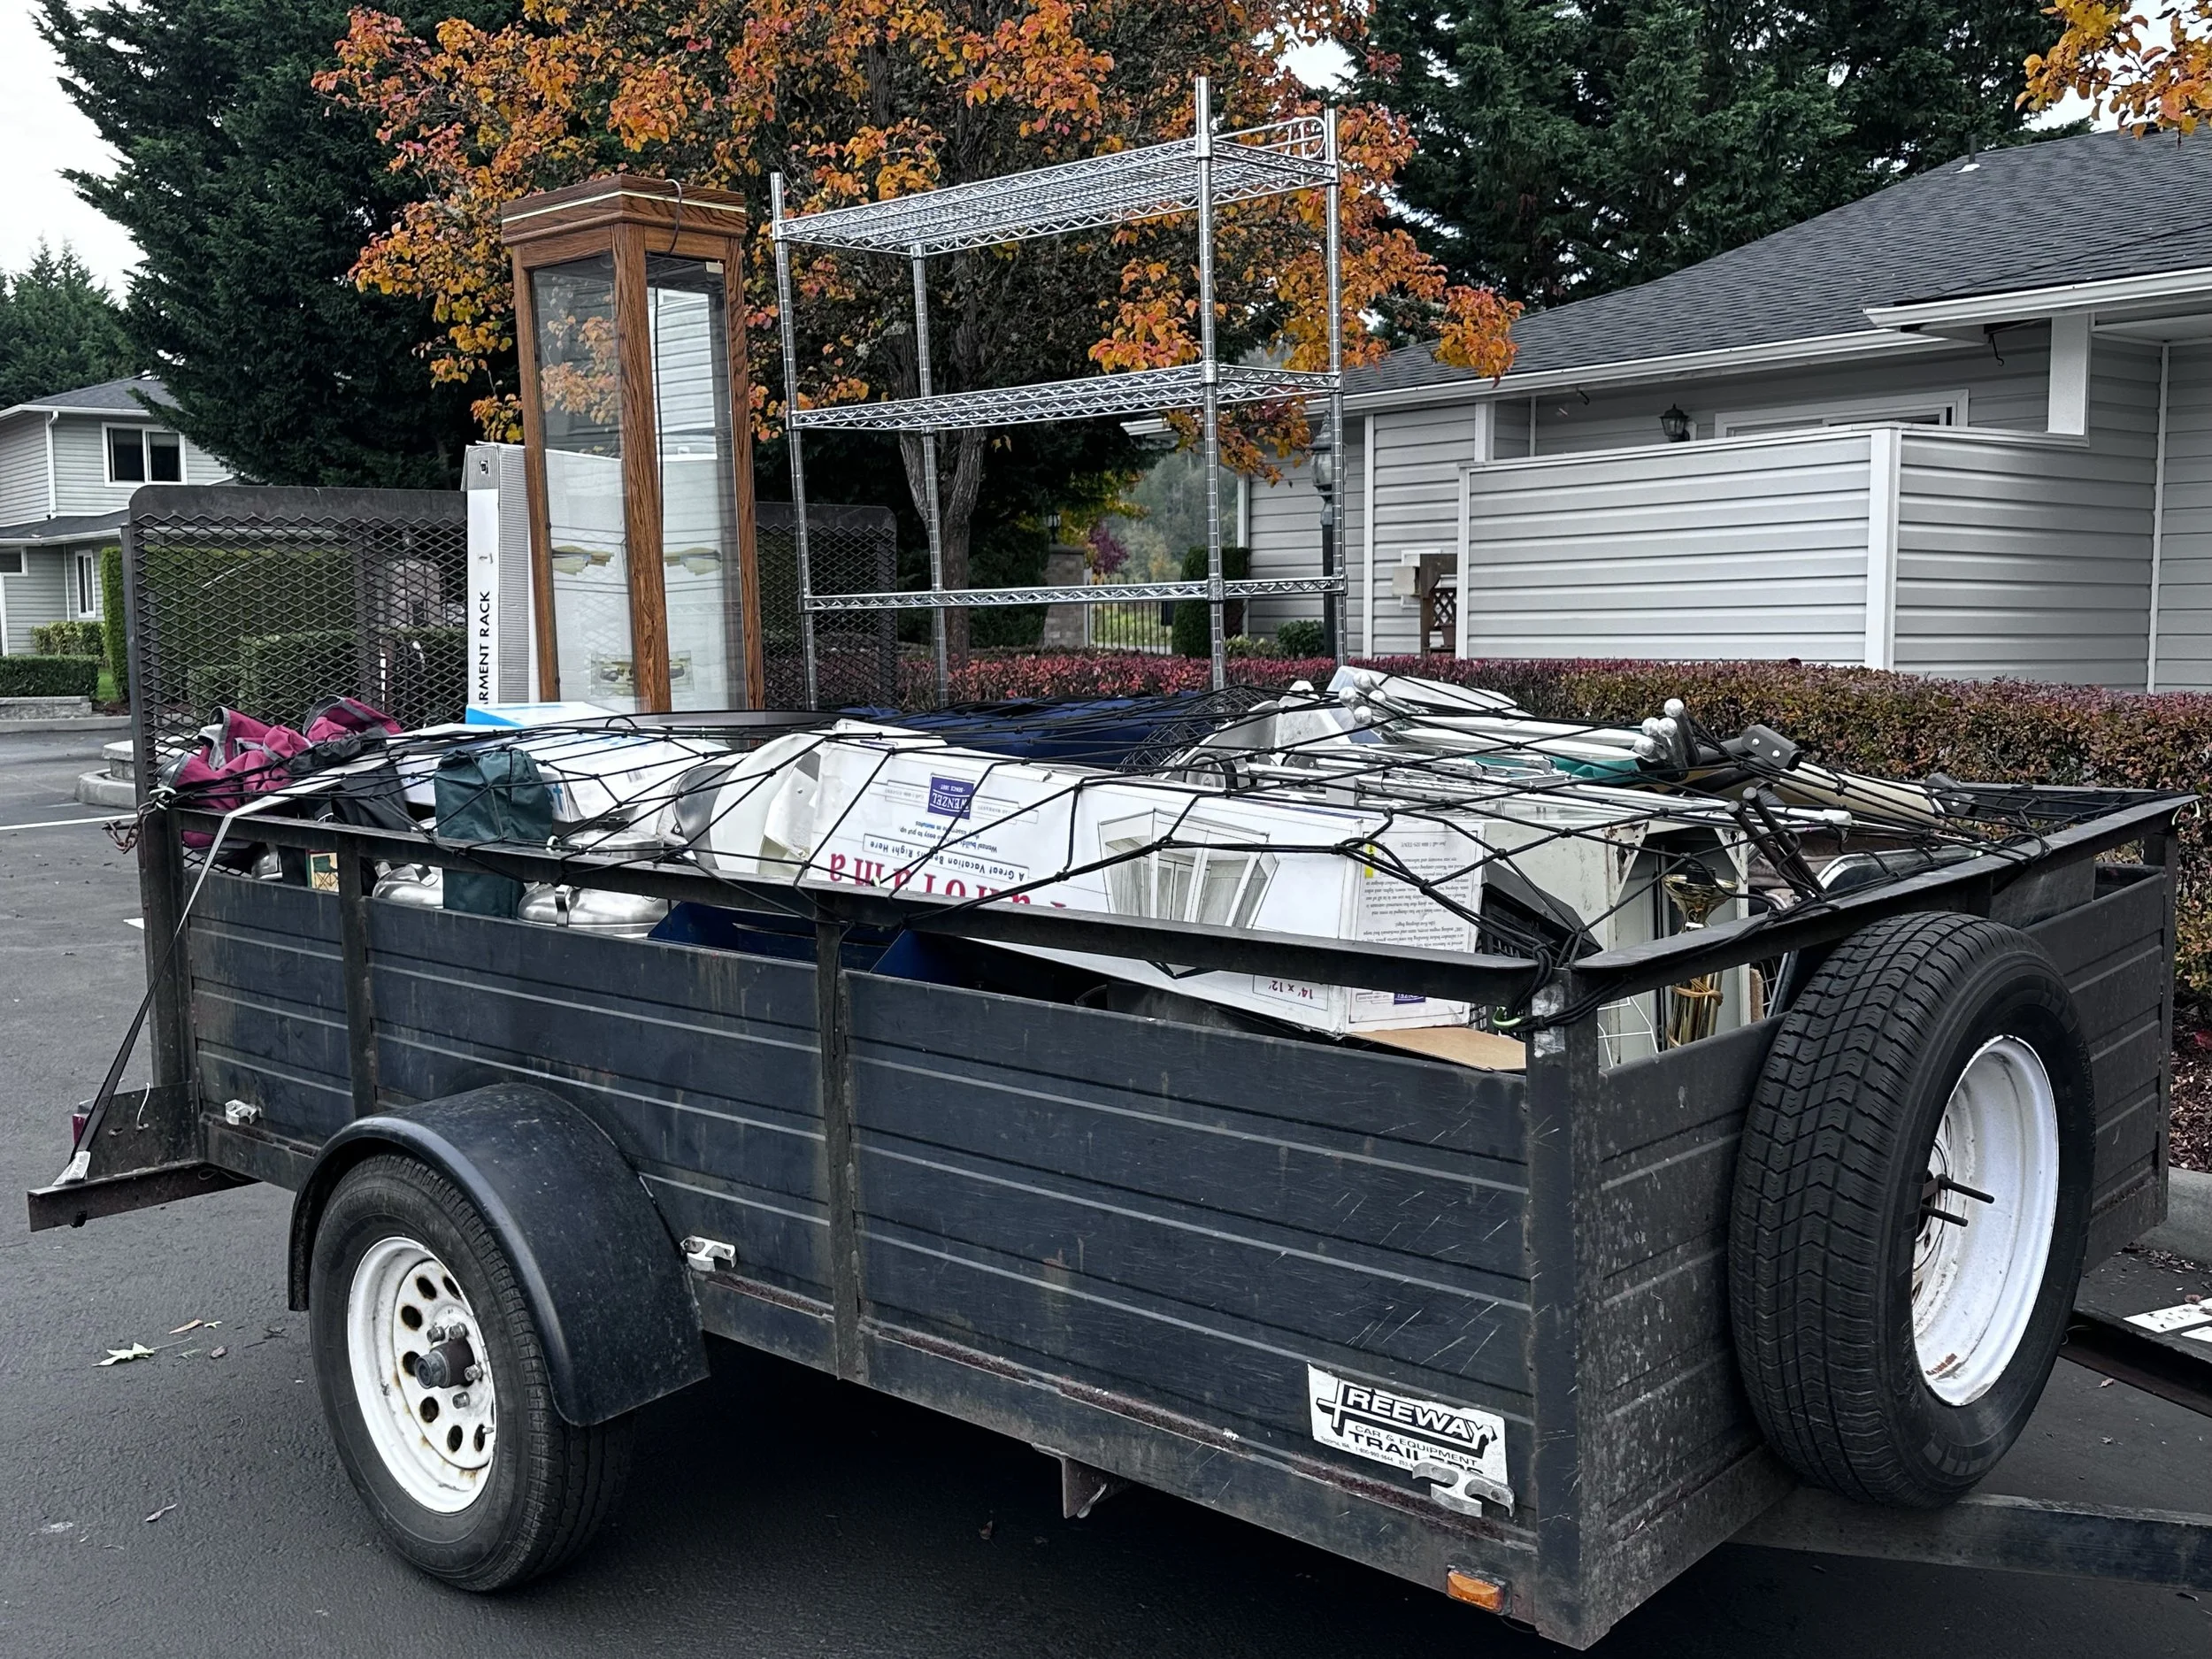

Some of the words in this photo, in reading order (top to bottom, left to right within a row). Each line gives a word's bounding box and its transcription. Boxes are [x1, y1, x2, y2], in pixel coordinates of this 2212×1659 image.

[480, 591, 490, 637] RACK
[479, 643, 489, 704] RMENT
[932, 793, 969, 810] WENZEL
[924, 831, 936, 840] easy
[870, 841, 889, 853] Here
[891, 845, 913, 858] Right
[948, 857, 985, 874] Vacation
[989, 866, 1015, 880] Great
[1018, 872, 1025, 882] A
[1268, 980, 1284, 993] 12'
[1287, 984, 1294, 993] x
[1297, 987, 1314, 1000] 14'
[1348, 1430, 1484, 1475] TRAIL
[1355, 1425, 1381, 1438] CAR
[1399, 1437, 1478, 1467] EQUIPMENT
